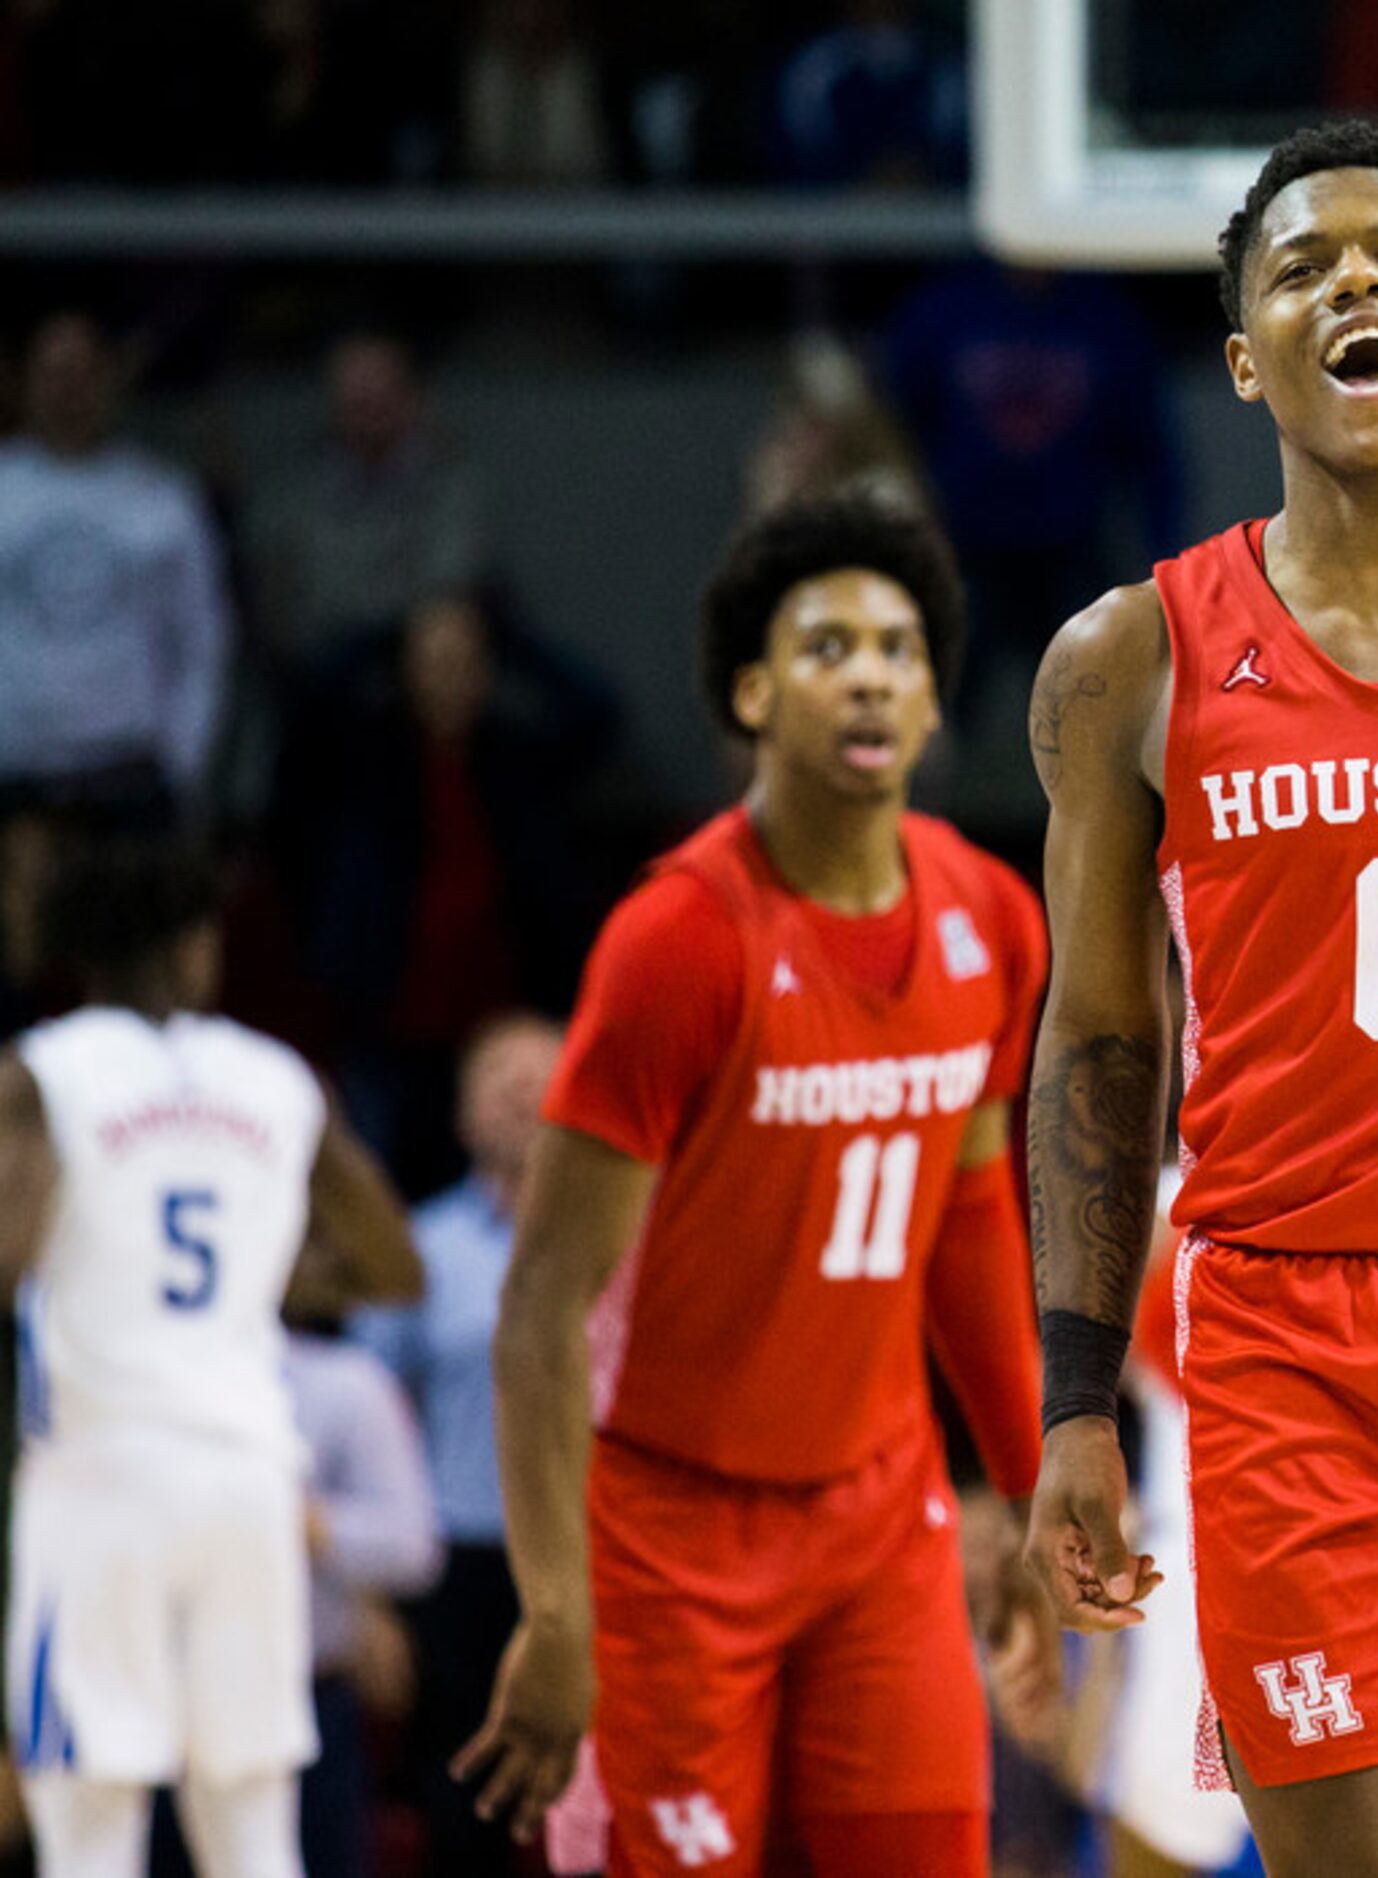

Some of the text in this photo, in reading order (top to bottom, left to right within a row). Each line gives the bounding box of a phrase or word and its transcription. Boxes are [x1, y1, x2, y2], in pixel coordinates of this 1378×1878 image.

[750, 1040, 992, 1126] HOUSTON
[162, 1187, 217, 1313] 5
[819, 1132, 921, 1282] 11
